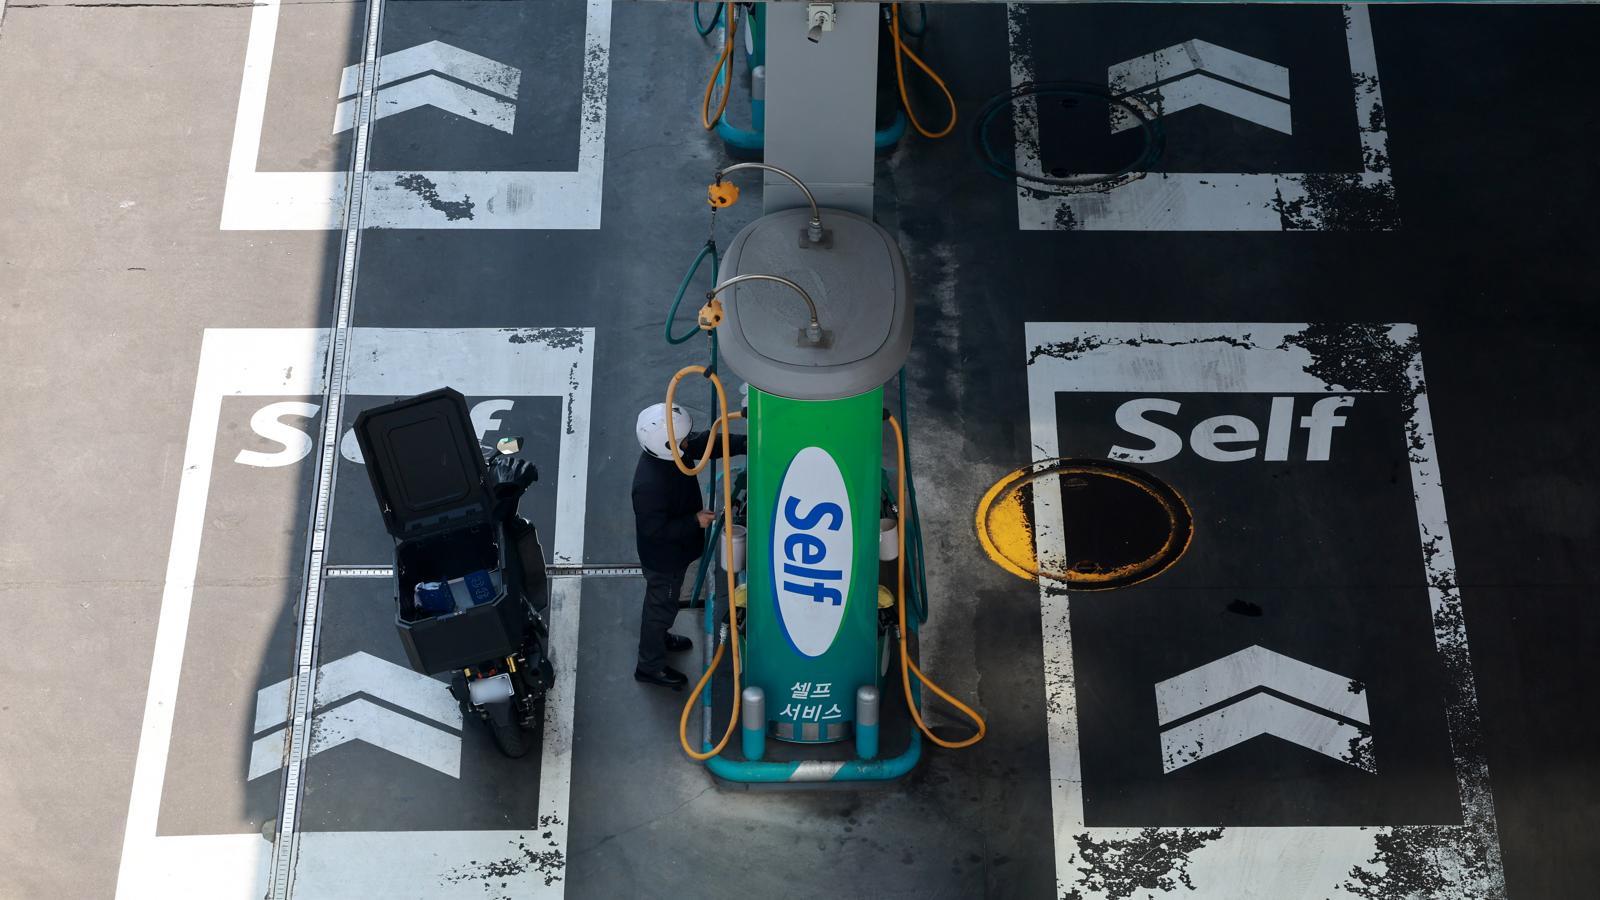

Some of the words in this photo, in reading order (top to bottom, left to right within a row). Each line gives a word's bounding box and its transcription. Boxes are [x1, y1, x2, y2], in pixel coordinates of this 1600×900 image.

[234, 399, 514, 468] Sf
[1108, 396, 1355, 463] Self
[784, 496, 843, 605] Self
[780, 704, 842, 722] 서비스
[791, 682, 832, 699] 셀프
